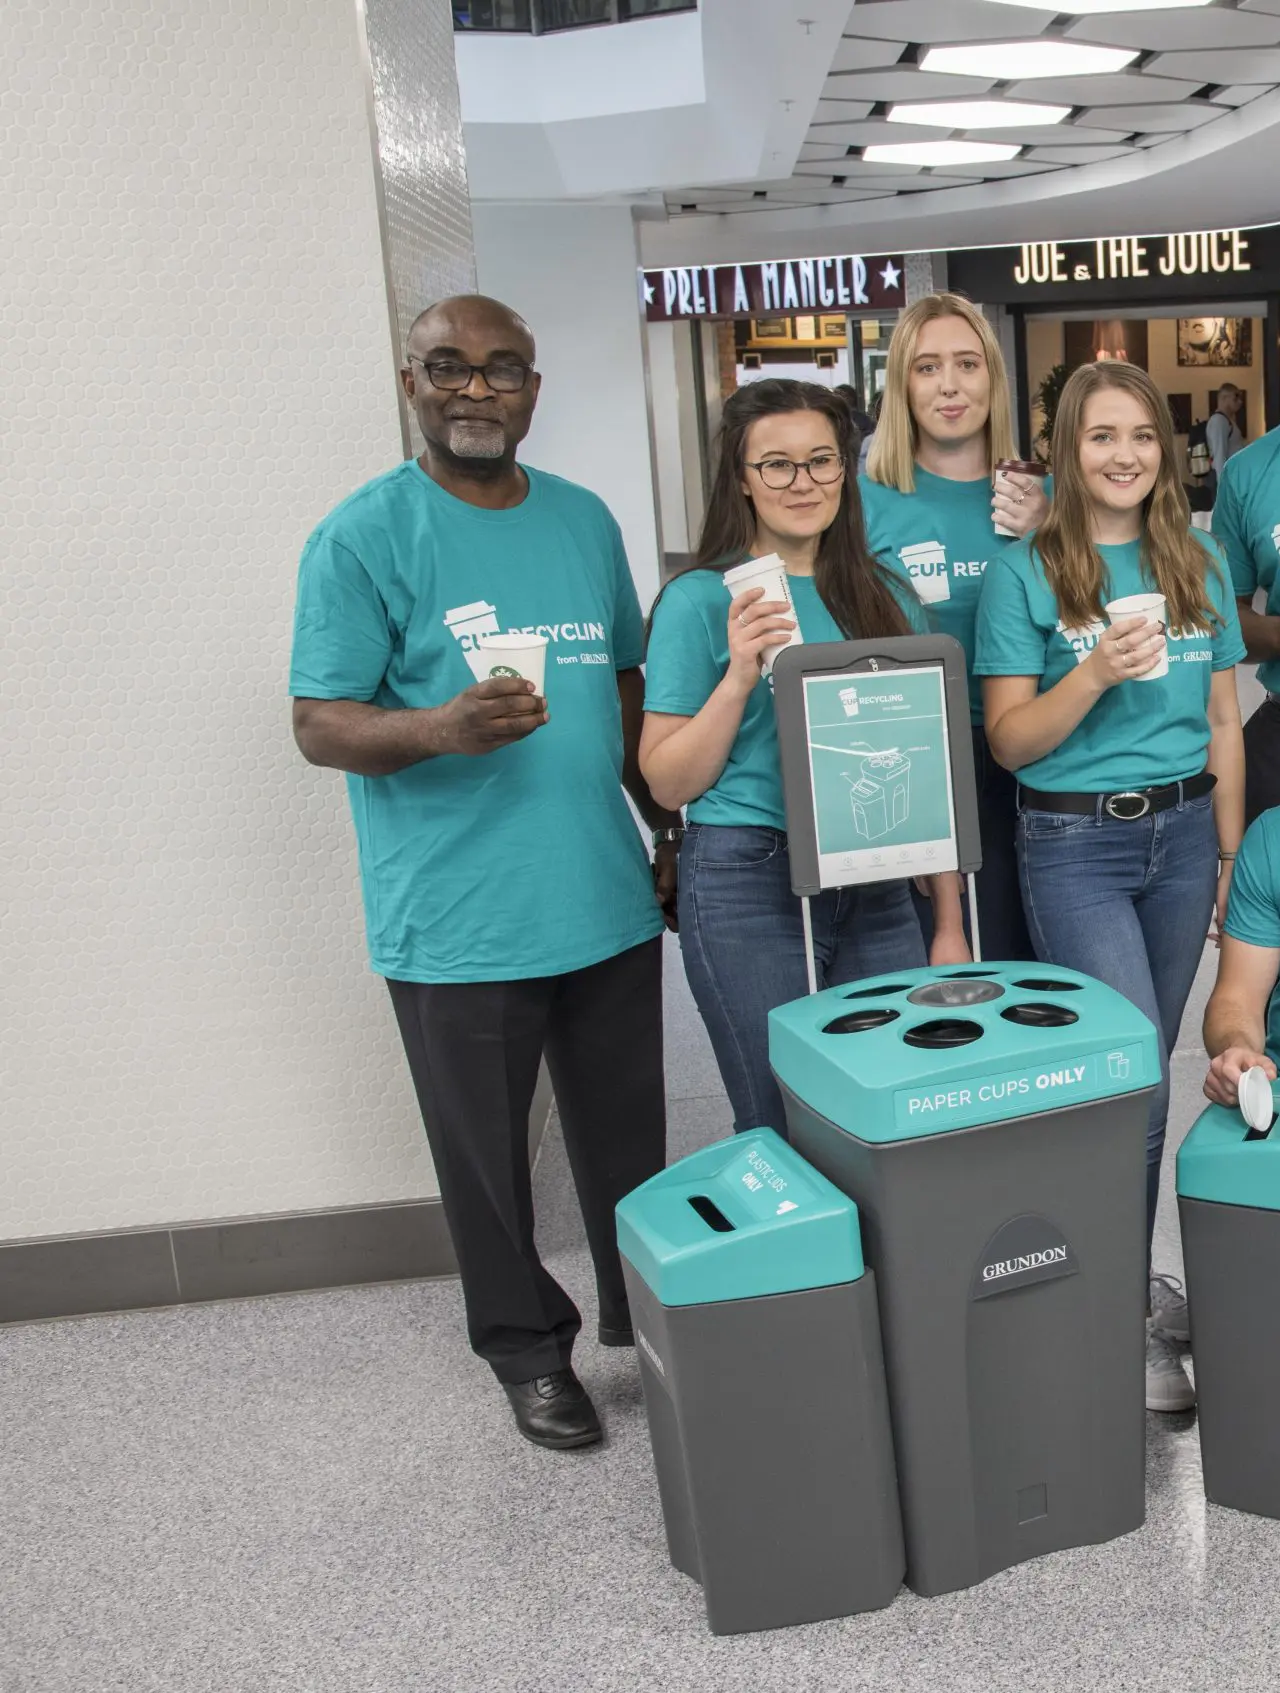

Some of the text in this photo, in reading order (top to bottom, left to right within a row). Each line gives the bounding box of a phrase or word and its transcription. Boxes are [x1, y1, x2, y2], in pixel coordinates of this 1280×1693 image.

[1014, 243, 1068, 284] JOE
[1074, 264, 1091, 281] &
[1159, 231, 1250, 275] JUICE
[662, 256, 869, 315] PRET A MANGER
[907, 562, 947, 578] CUP
[556, 653, 609, 665] from GRUND
[859, 694, 904, 705] RECYCLING
[908, 1065, 1085, 1115] PAPER CUPS ONLY
[742, 1171, 764, 1192] ONLY
[983, 1245, 1067, 1280] GRUNDON
